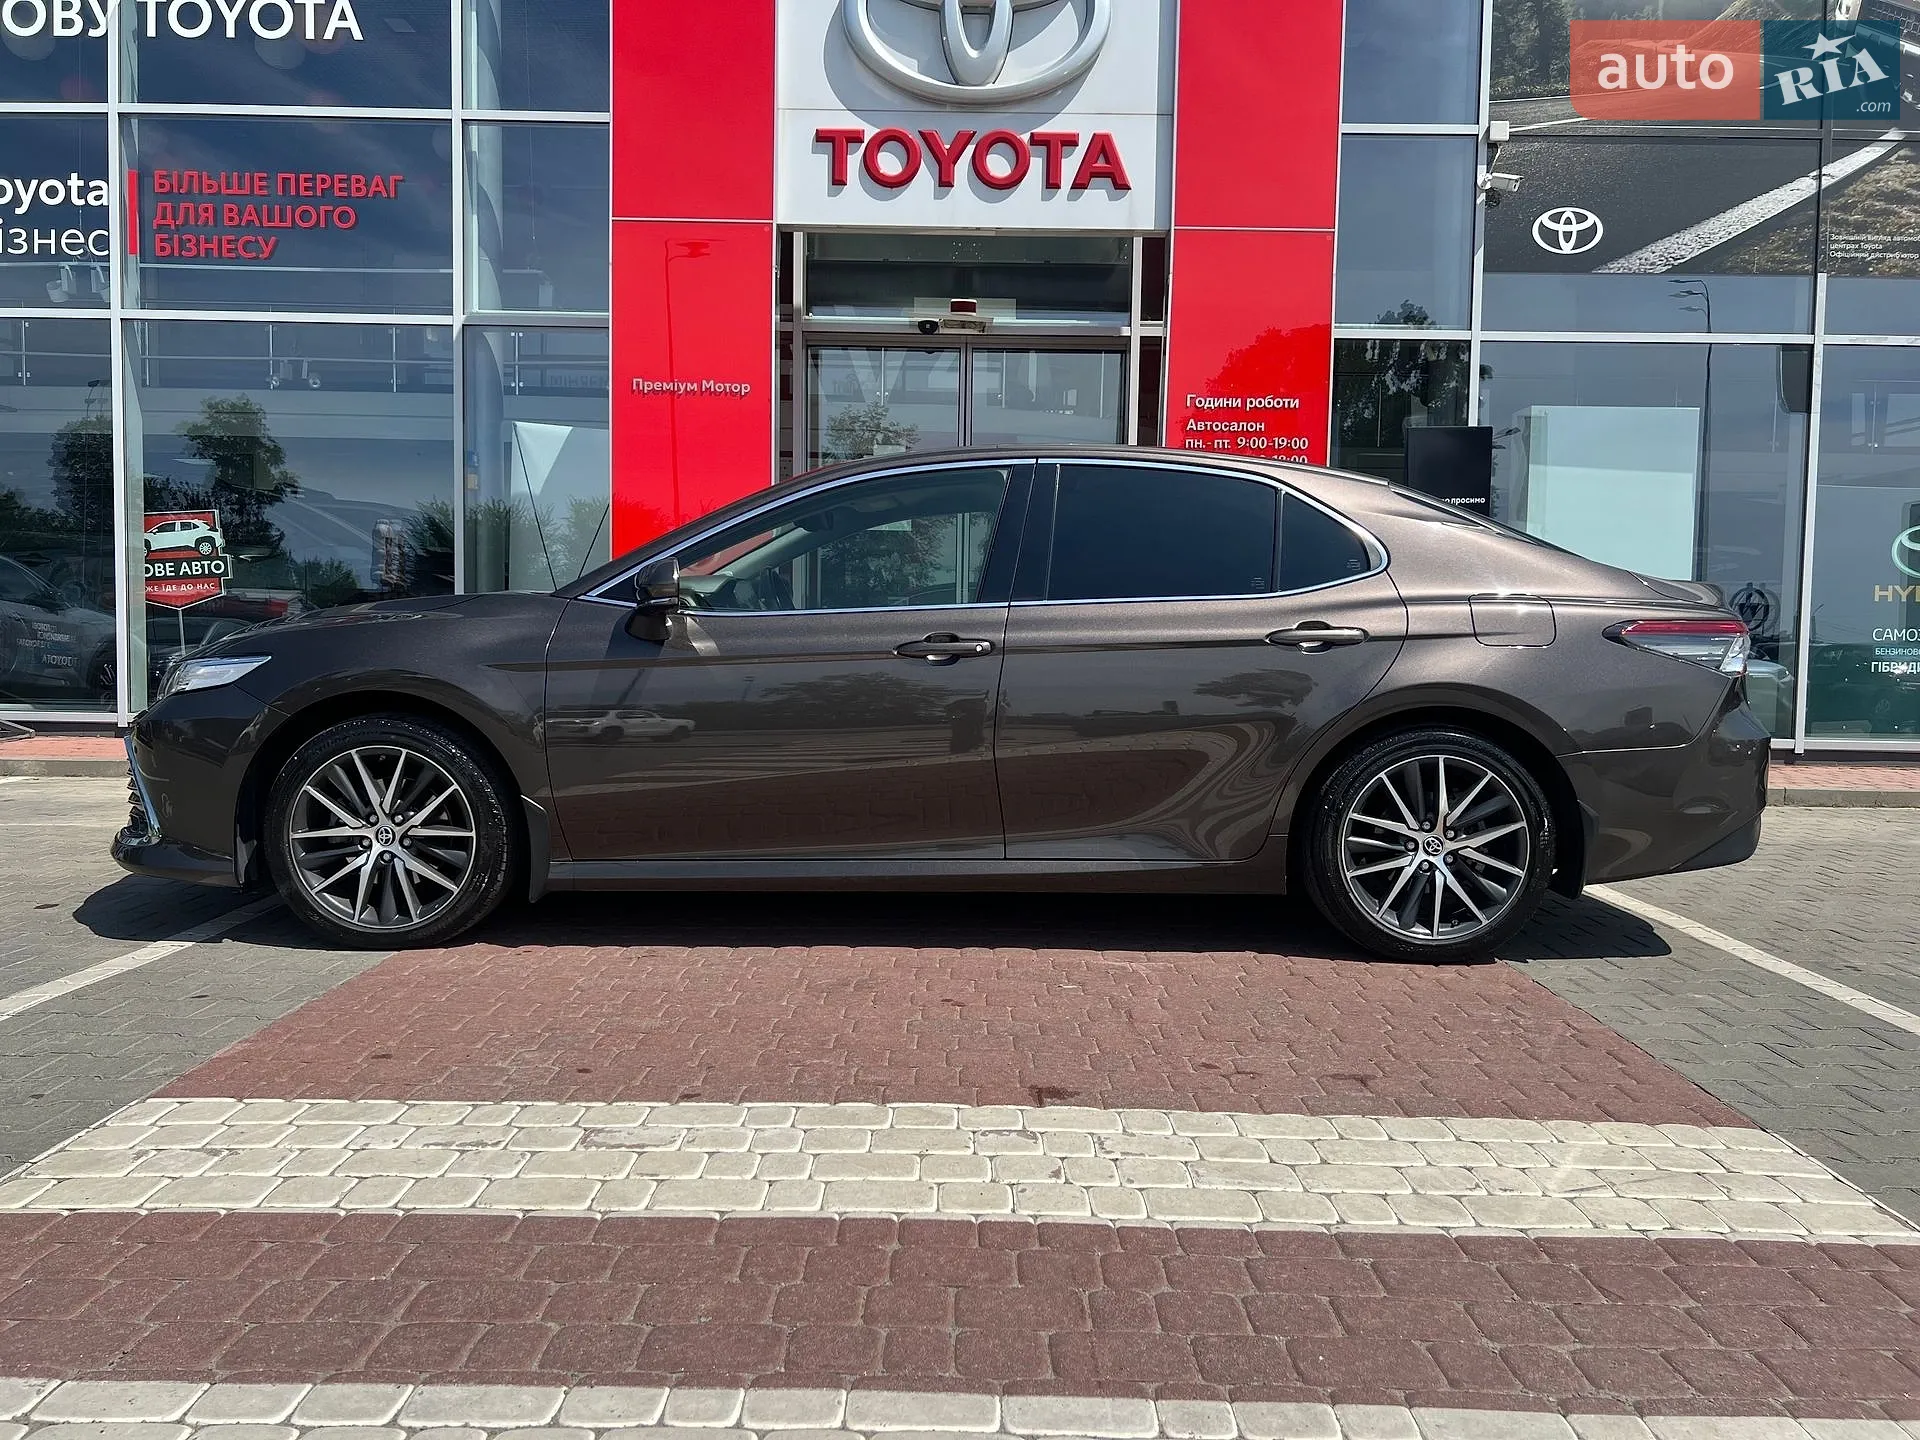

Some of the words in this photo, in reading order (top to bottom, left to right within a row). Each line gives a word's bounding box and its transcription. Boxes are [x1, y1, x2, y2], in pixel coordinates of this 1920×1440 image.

[136, 0, 364, 41] TOYOTA
[815, 127, 1132, 190] TOYOTA
[153, 169, 269, 195] БІЛЬШЕ
[277, 173, 404, 198] ПЕРЕВАГ
[152, 202, 214, 230] ДЛЯ
[223, 203, 356, 228] ВАШОГО
[155, 233, 277, 259] БІЗНЕСУ
[1861, 242, 1883, 250] Toyota
[632, 378, 697, 394] Преміум
[701, 379, 751, 395] Мотор
[1186, 394, 1241, 409] Години
[1246, 395, 1299, 411] роботи
[1186, 419, 1265, 431] Автосалон
[1237, 436, 1309, 449] 9:00-19:00
[180, 560, 225, 576] АВТО
[162, 583, 177, 592] ЇДЕ
[180, 583, 193, 591] ДО
[197, 582, 215, 590] НАС
[1875, 647, 1920, 656] БЕНЗИНОВ
